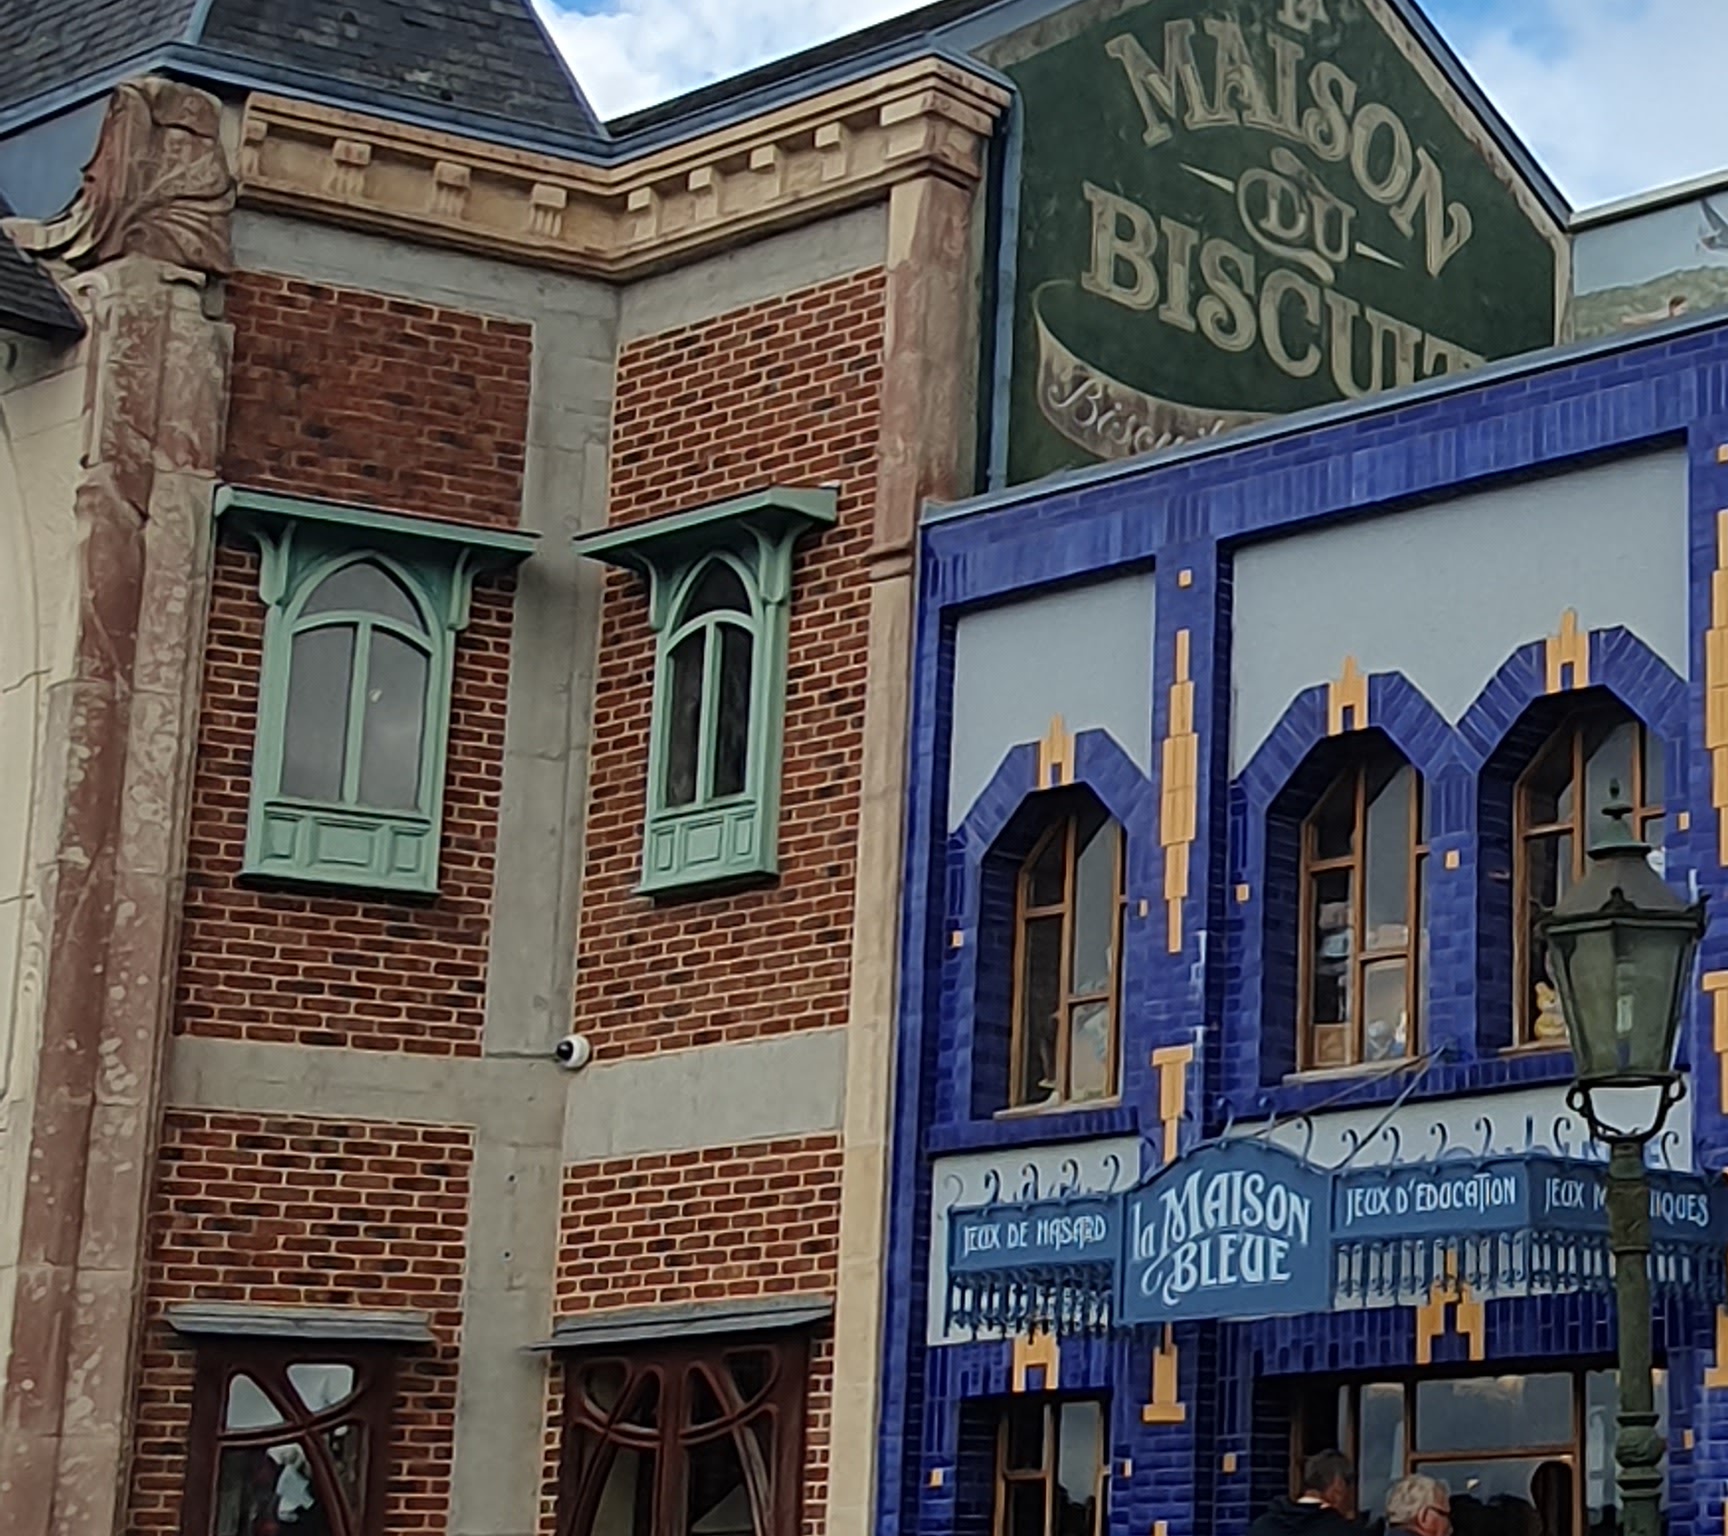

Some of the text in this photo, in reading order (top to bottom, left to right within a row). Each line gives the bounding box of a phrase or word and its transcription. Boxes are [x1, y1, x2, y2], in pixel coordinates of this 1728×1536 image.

[1105, 18, 1472, 277] MAISON
[1238, 154, 1357, 278] DU
[1150, 1169, 1312, 1264] MAISON
[1346, 1185, 1391, 1226] JEUX
[1544, 1177, 1585, 1214] JEUX
[1006, 1220, 1028, 1249] DE
[1162, 1233, 1292, 1306] BLEUE
